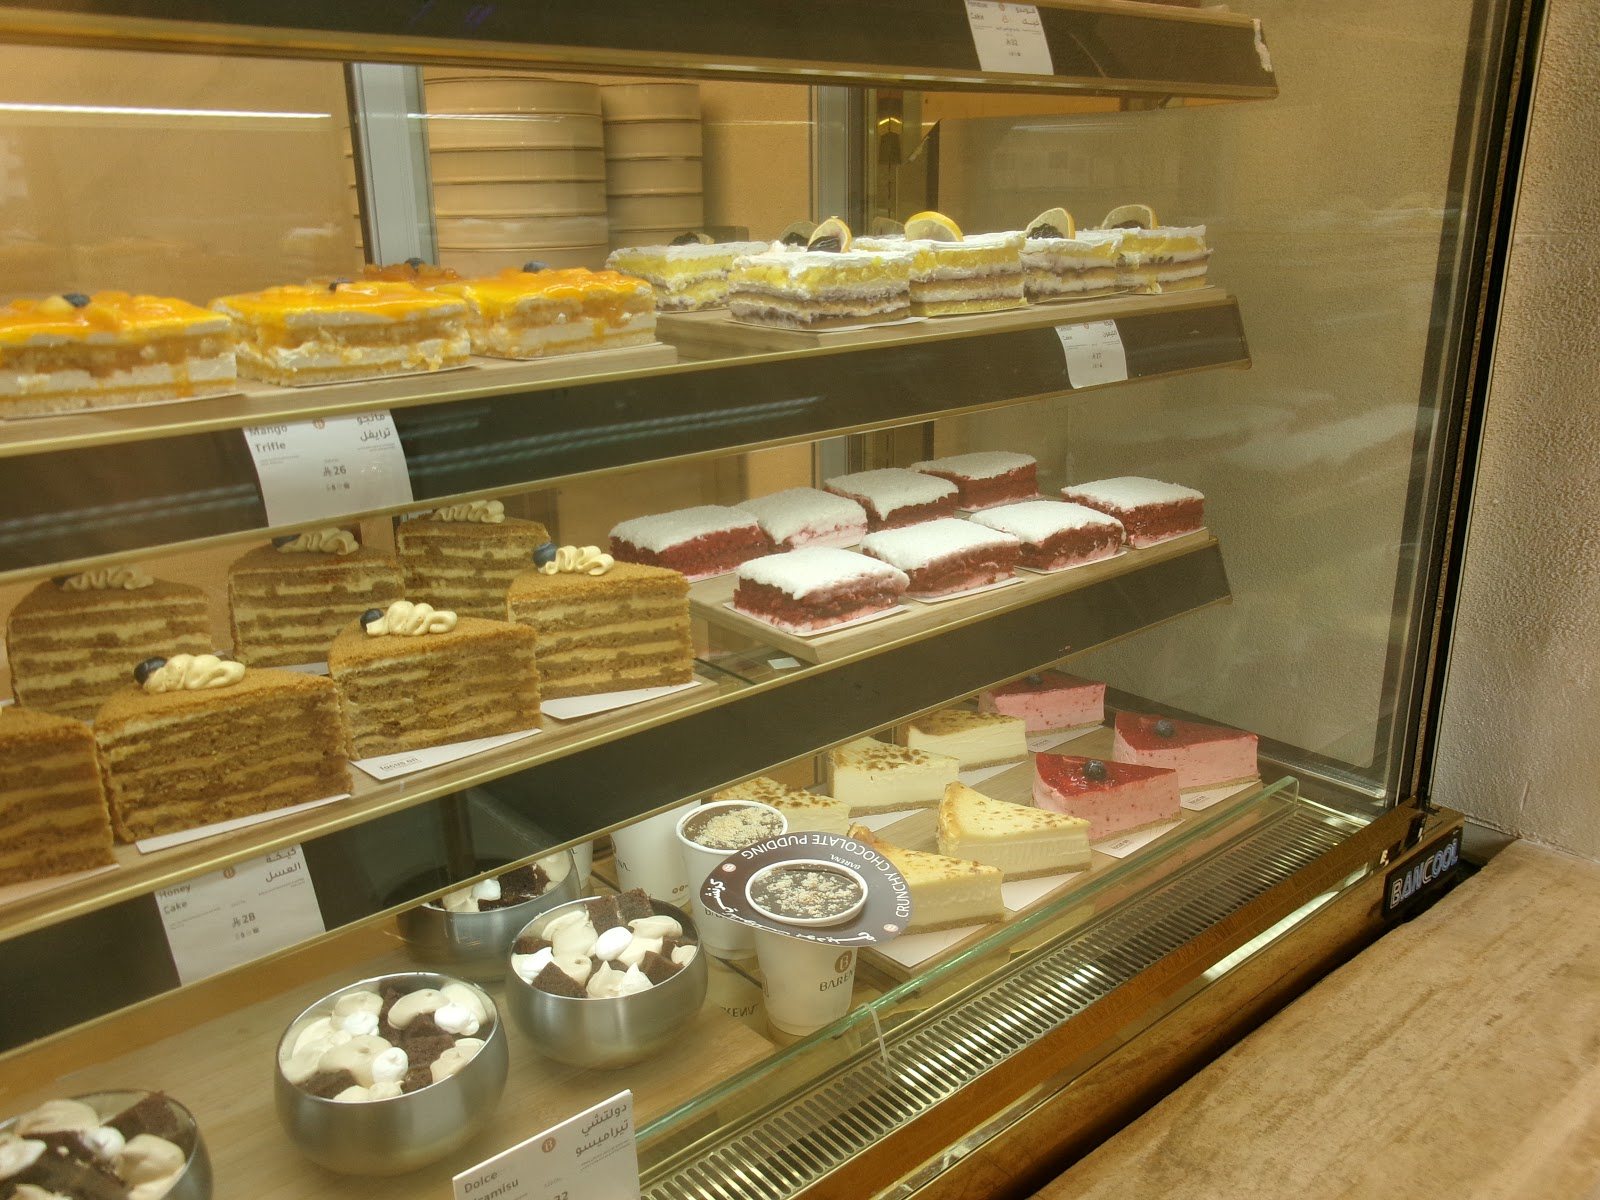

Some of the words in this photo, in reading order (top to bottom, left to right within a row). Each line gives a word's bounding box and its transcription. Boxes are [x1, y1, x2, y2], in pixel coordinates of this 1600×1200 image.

[255, 442, 287, 453] Trifle
[740, 833, 808, 860] PUDDING
[811, 833, 890, 873] CHOCOLATE
[265, 862, 301, 883] العسل
[884, 869, 911, 919] CRUNCHY
[163, 901, 188, 915] Cake
[581, 1104, 627, 1137] دولتشي
[575, 1119, 629, 1158] تيراميسو
[463, 1171, 498, 1194] Dolce
